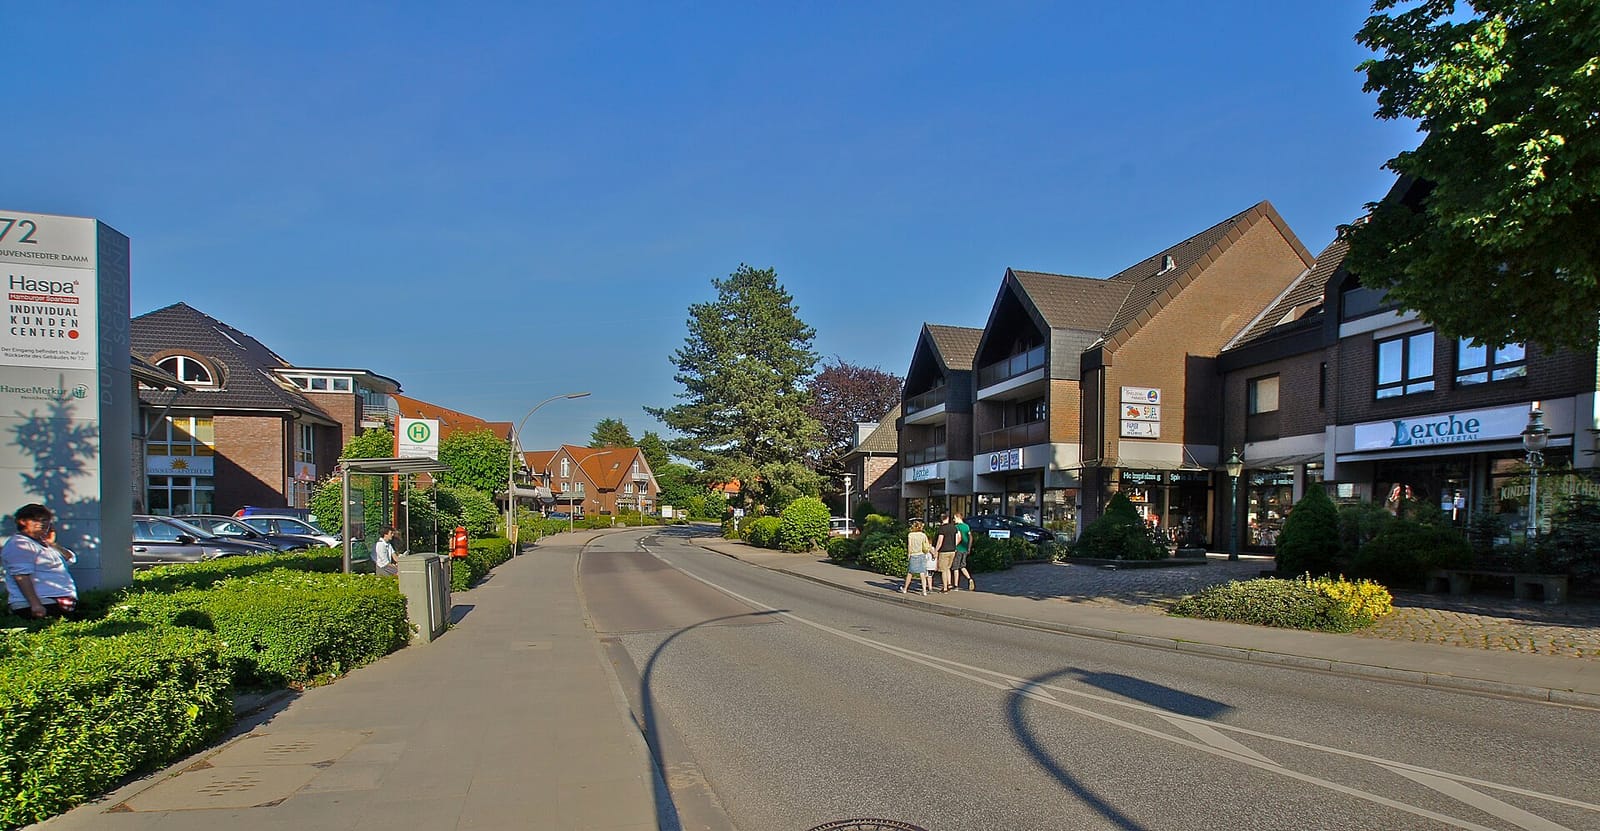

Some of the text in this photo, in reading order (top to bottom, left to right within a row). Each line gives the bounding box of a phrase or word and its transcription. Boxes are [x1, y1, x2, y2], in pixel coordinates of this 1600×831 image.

[0, 218, 37, 244] 72
[62, 254, 88, 262] DAMM
[10, 275, 75, 294] Haspa
[112, 236, 126, 345] SCHEUNE
[11, 304, 78, 316] INDIVIDUAL
[11, 316, 78, 327] KUNDEN
[11, 327, 65, 338] CENTER
[0, 385, 67, 396] HanseMerkur
[413, 426, 424, 438] H
[1390, 415, 1480, 447] Lerche
[1430, 434, 1479, 445] ALSTERTAL
[1500, 485, 1531, 501] KINDE
